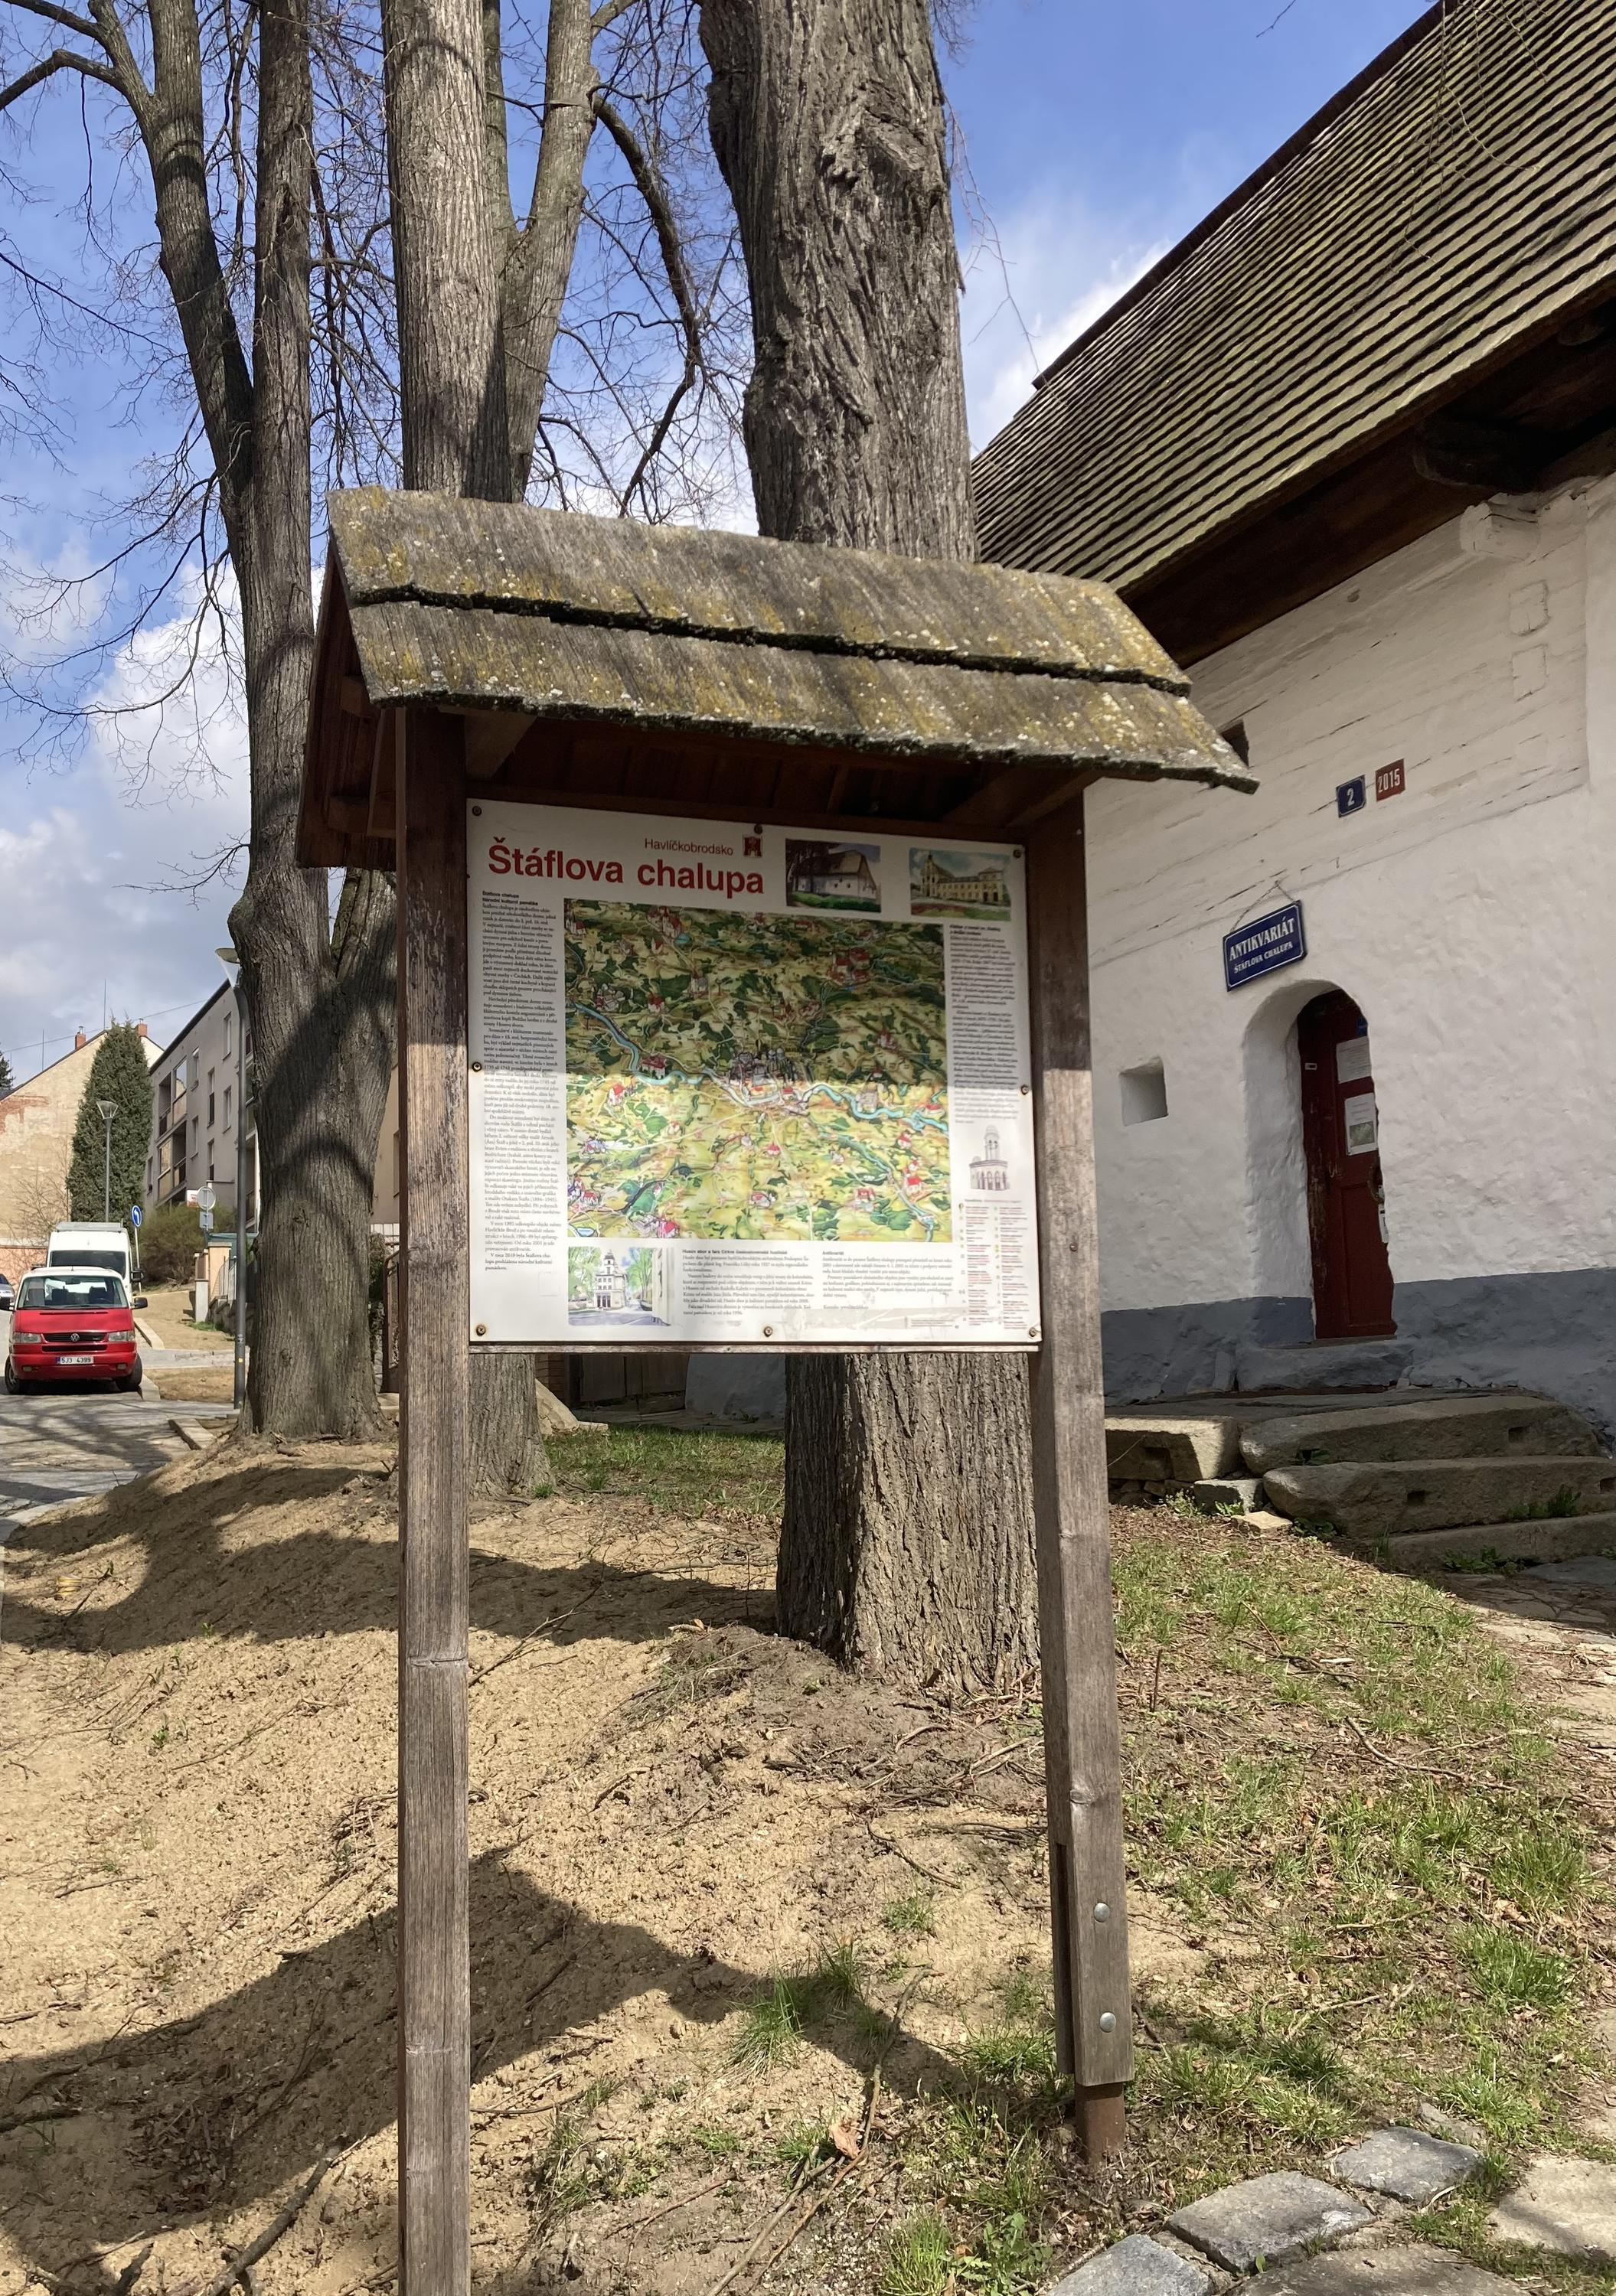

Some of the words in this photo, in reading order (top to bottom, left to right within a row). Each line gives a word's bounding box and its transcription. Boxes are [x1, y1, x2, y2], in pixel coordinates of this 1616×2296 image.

[1378, 768, 1400, 792] 2015
[1347, 788, 1354, 806] 2
[645, 838, 733, 856] Havlíčkobrodsko
[488, 837, 624, 884] Štáflova
[637, 859, 765, 899] chalupa
[1229, 916, 1294, 961] ANTIKVARIÁT
[1234, 954, 1264, 974] ŠTÁFLOVA
[1264, 941, 1293, 959] CHALUPA
